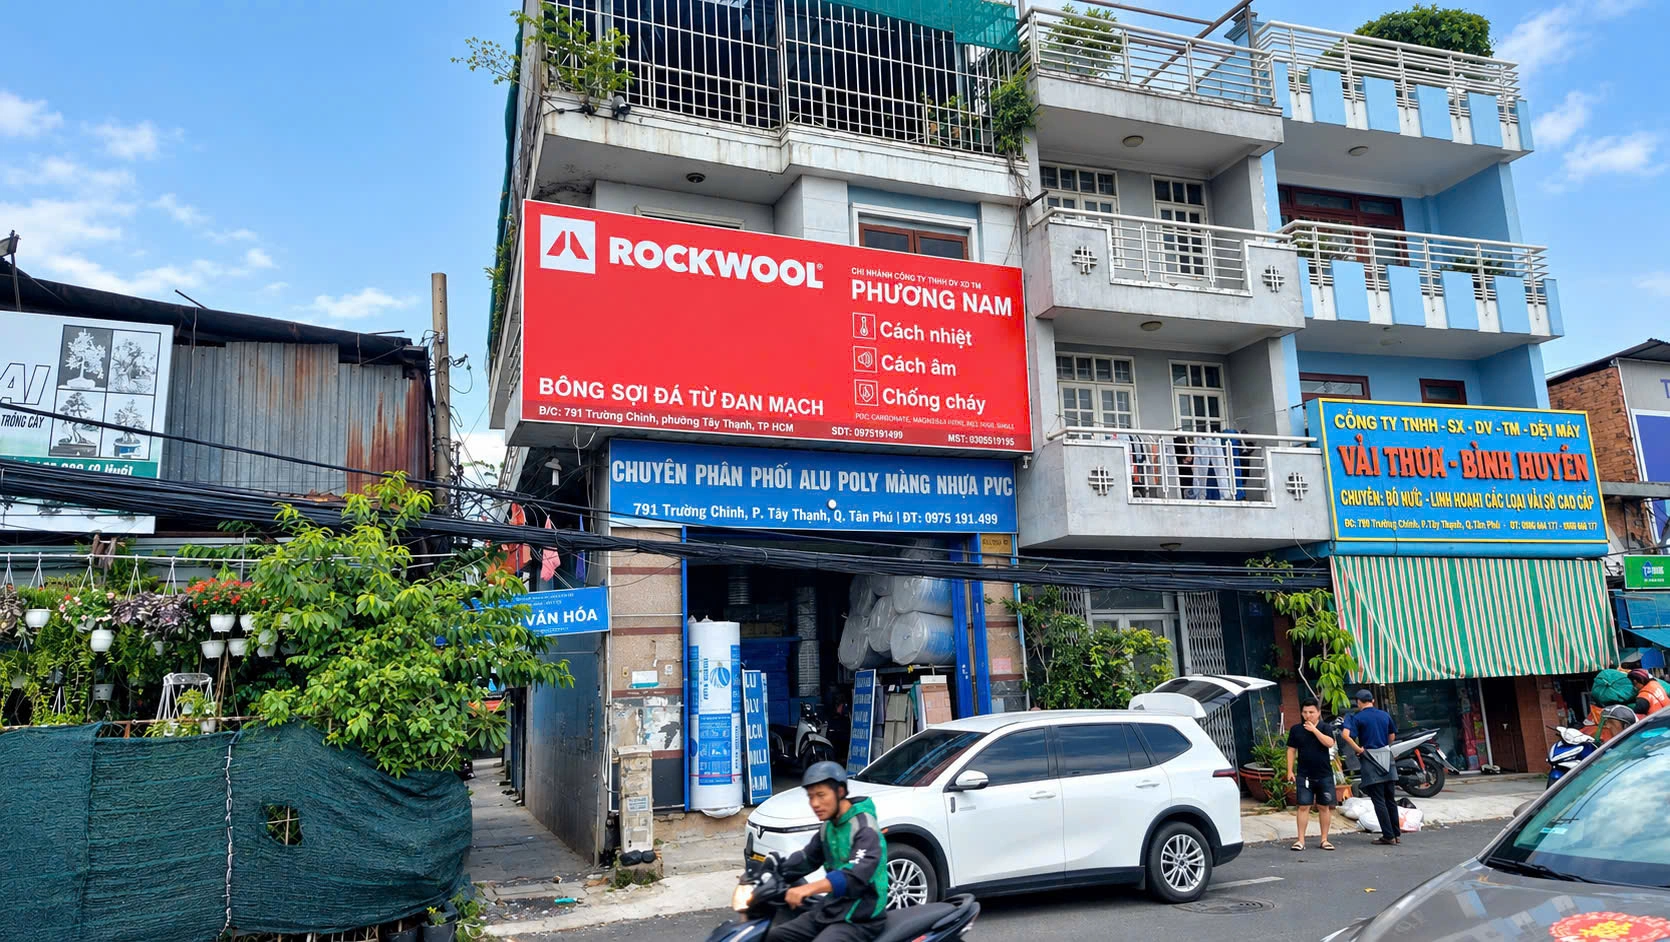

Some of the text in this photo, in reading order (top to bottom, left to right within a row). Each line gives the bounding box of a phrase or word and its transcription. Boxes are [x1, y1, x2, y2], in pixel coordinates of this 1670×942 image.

[851, 279, 1012, 317] PHƯƠNG NAM
[880, 321, 972, 349] Cách nhiệt
[881, 354, 957, 376] Cách âm
[538, 375, 824, 418] BÔNG SỢI ĐÁ TỪ ĐAN MẠCH
[882, 386, 986, 415] Chống cháy
[564, 407, 583, 418] 791
[585, 407, 624, 423] Trường
[661, 412, 700, 428] phường
[702, 416, 721, 429] Tây
[723, 417, 755, 432] Thạnh,
[757, 421, 770, 431] TP
[772, 421, 794, 432] HCM
[1334, 408, 1378, 430] CÔNG
[1380, 416, 1398, 431] TY
[1401, 417, 1439, 433] TNHH
[1447, 419, 1467, 434] SX
[1474, 420, 1492, 435] DV
[1501, 421, 1521, 436] TM
[1555, 420, 1580, 438] MÁY
[947, 433, 968, 444] MST:
[1338, 433, 1381, 476] VẢI
[611, 457, 1013, 499] CHUYÊN PHÂN PHỐI ALU POLY MÀNG NHỰA PVC
[633, 503, 657, 516] 791
[662, 503, 707, 521] Trường
[752, 508, 764, 519] P.
[768, 508, 789, 523] Tây
[791, 508, 831, 525] Thạnh,
[833, 510, 846, 524] Q.
[848, 510, 869, 523] Tân
[872, 511, 894, 524] Phú
[902, 512, 922, 524] ĐT:
[924, 512, 951, 524] 0975
[954, 513, 998, 525] 191.499
[1557, 494, 1576, 510] CAO
[525, 605, 598, 627] VĂN HÓA
